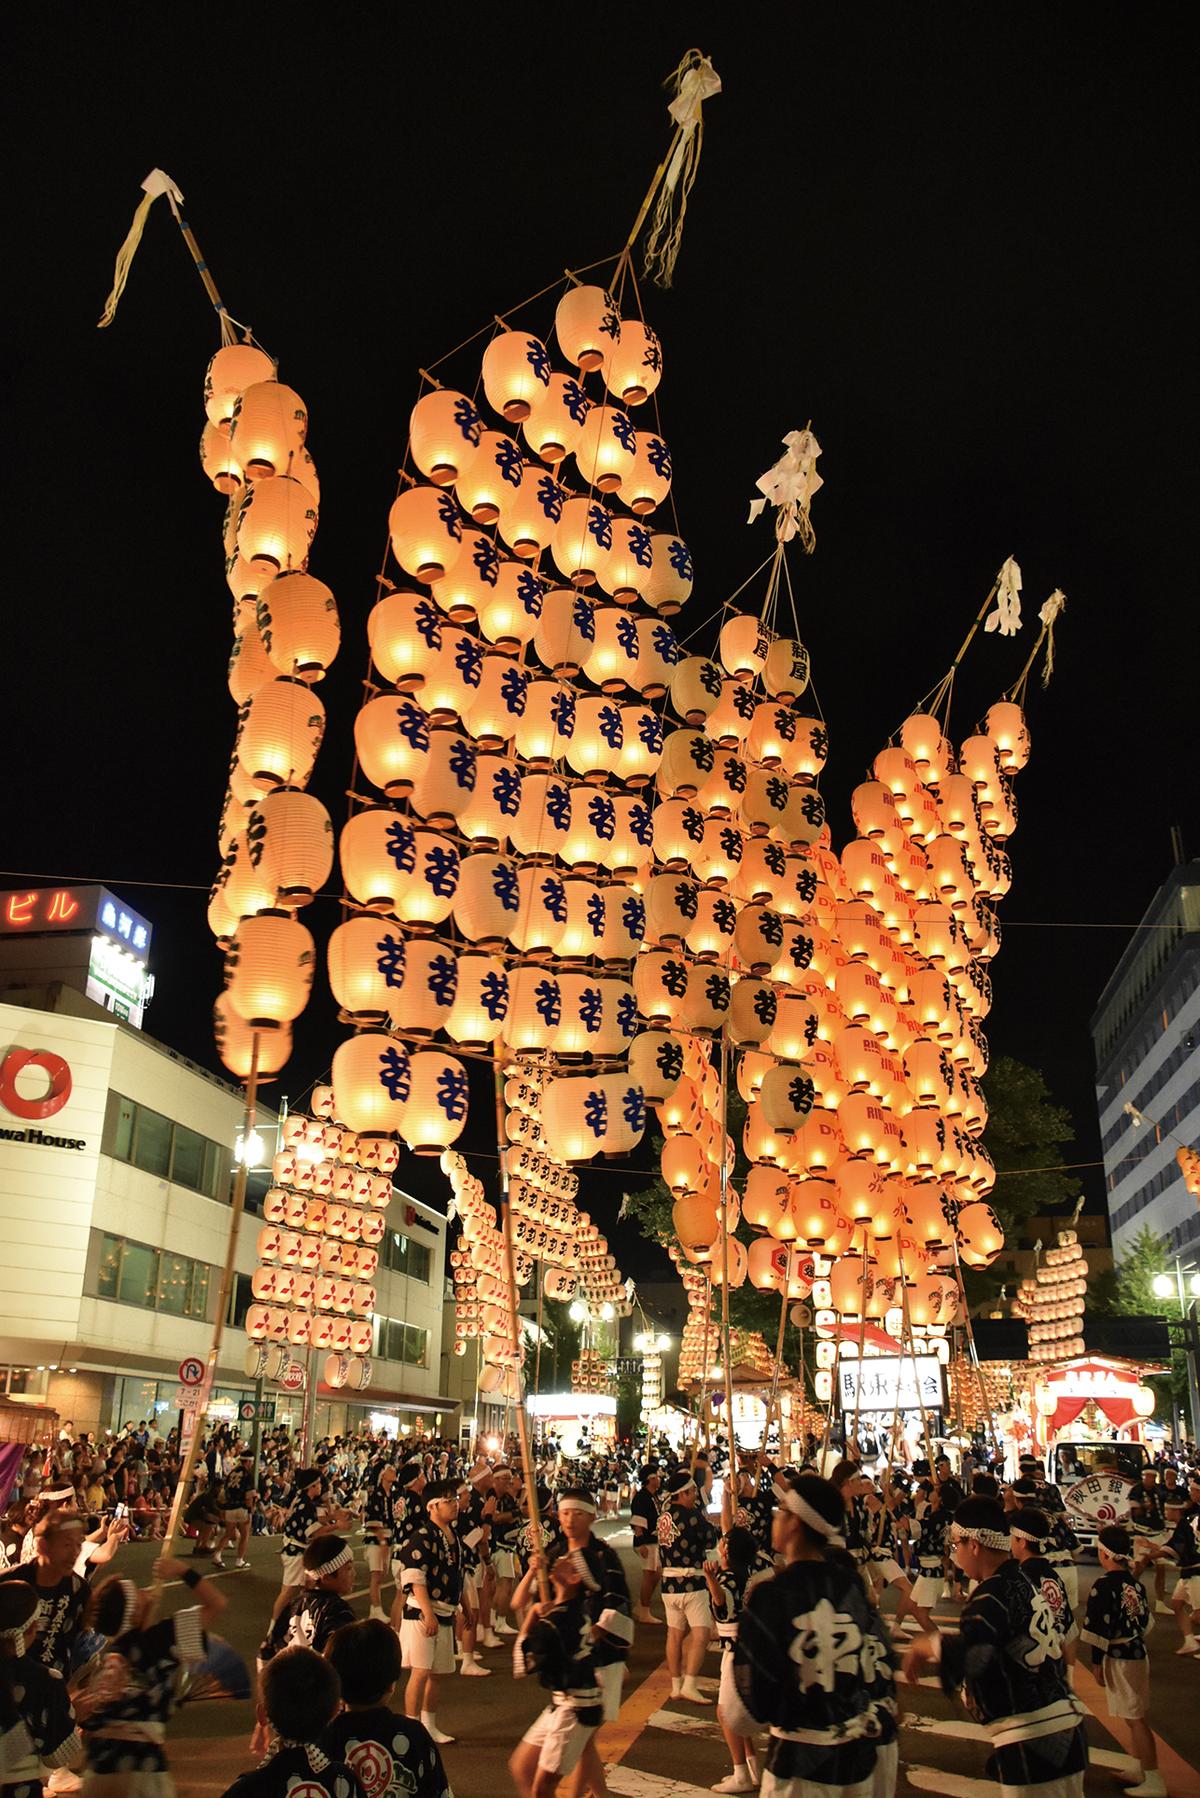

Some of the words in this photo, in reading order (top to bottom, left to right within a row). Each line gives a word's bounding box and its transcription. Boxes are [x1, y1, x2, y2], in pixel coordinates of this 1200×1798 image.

[9, 892, 77, 922] ビル
[28, 1129, 86, 1150] House
[1070, 1478, 1125, 1505] 秋田銀
